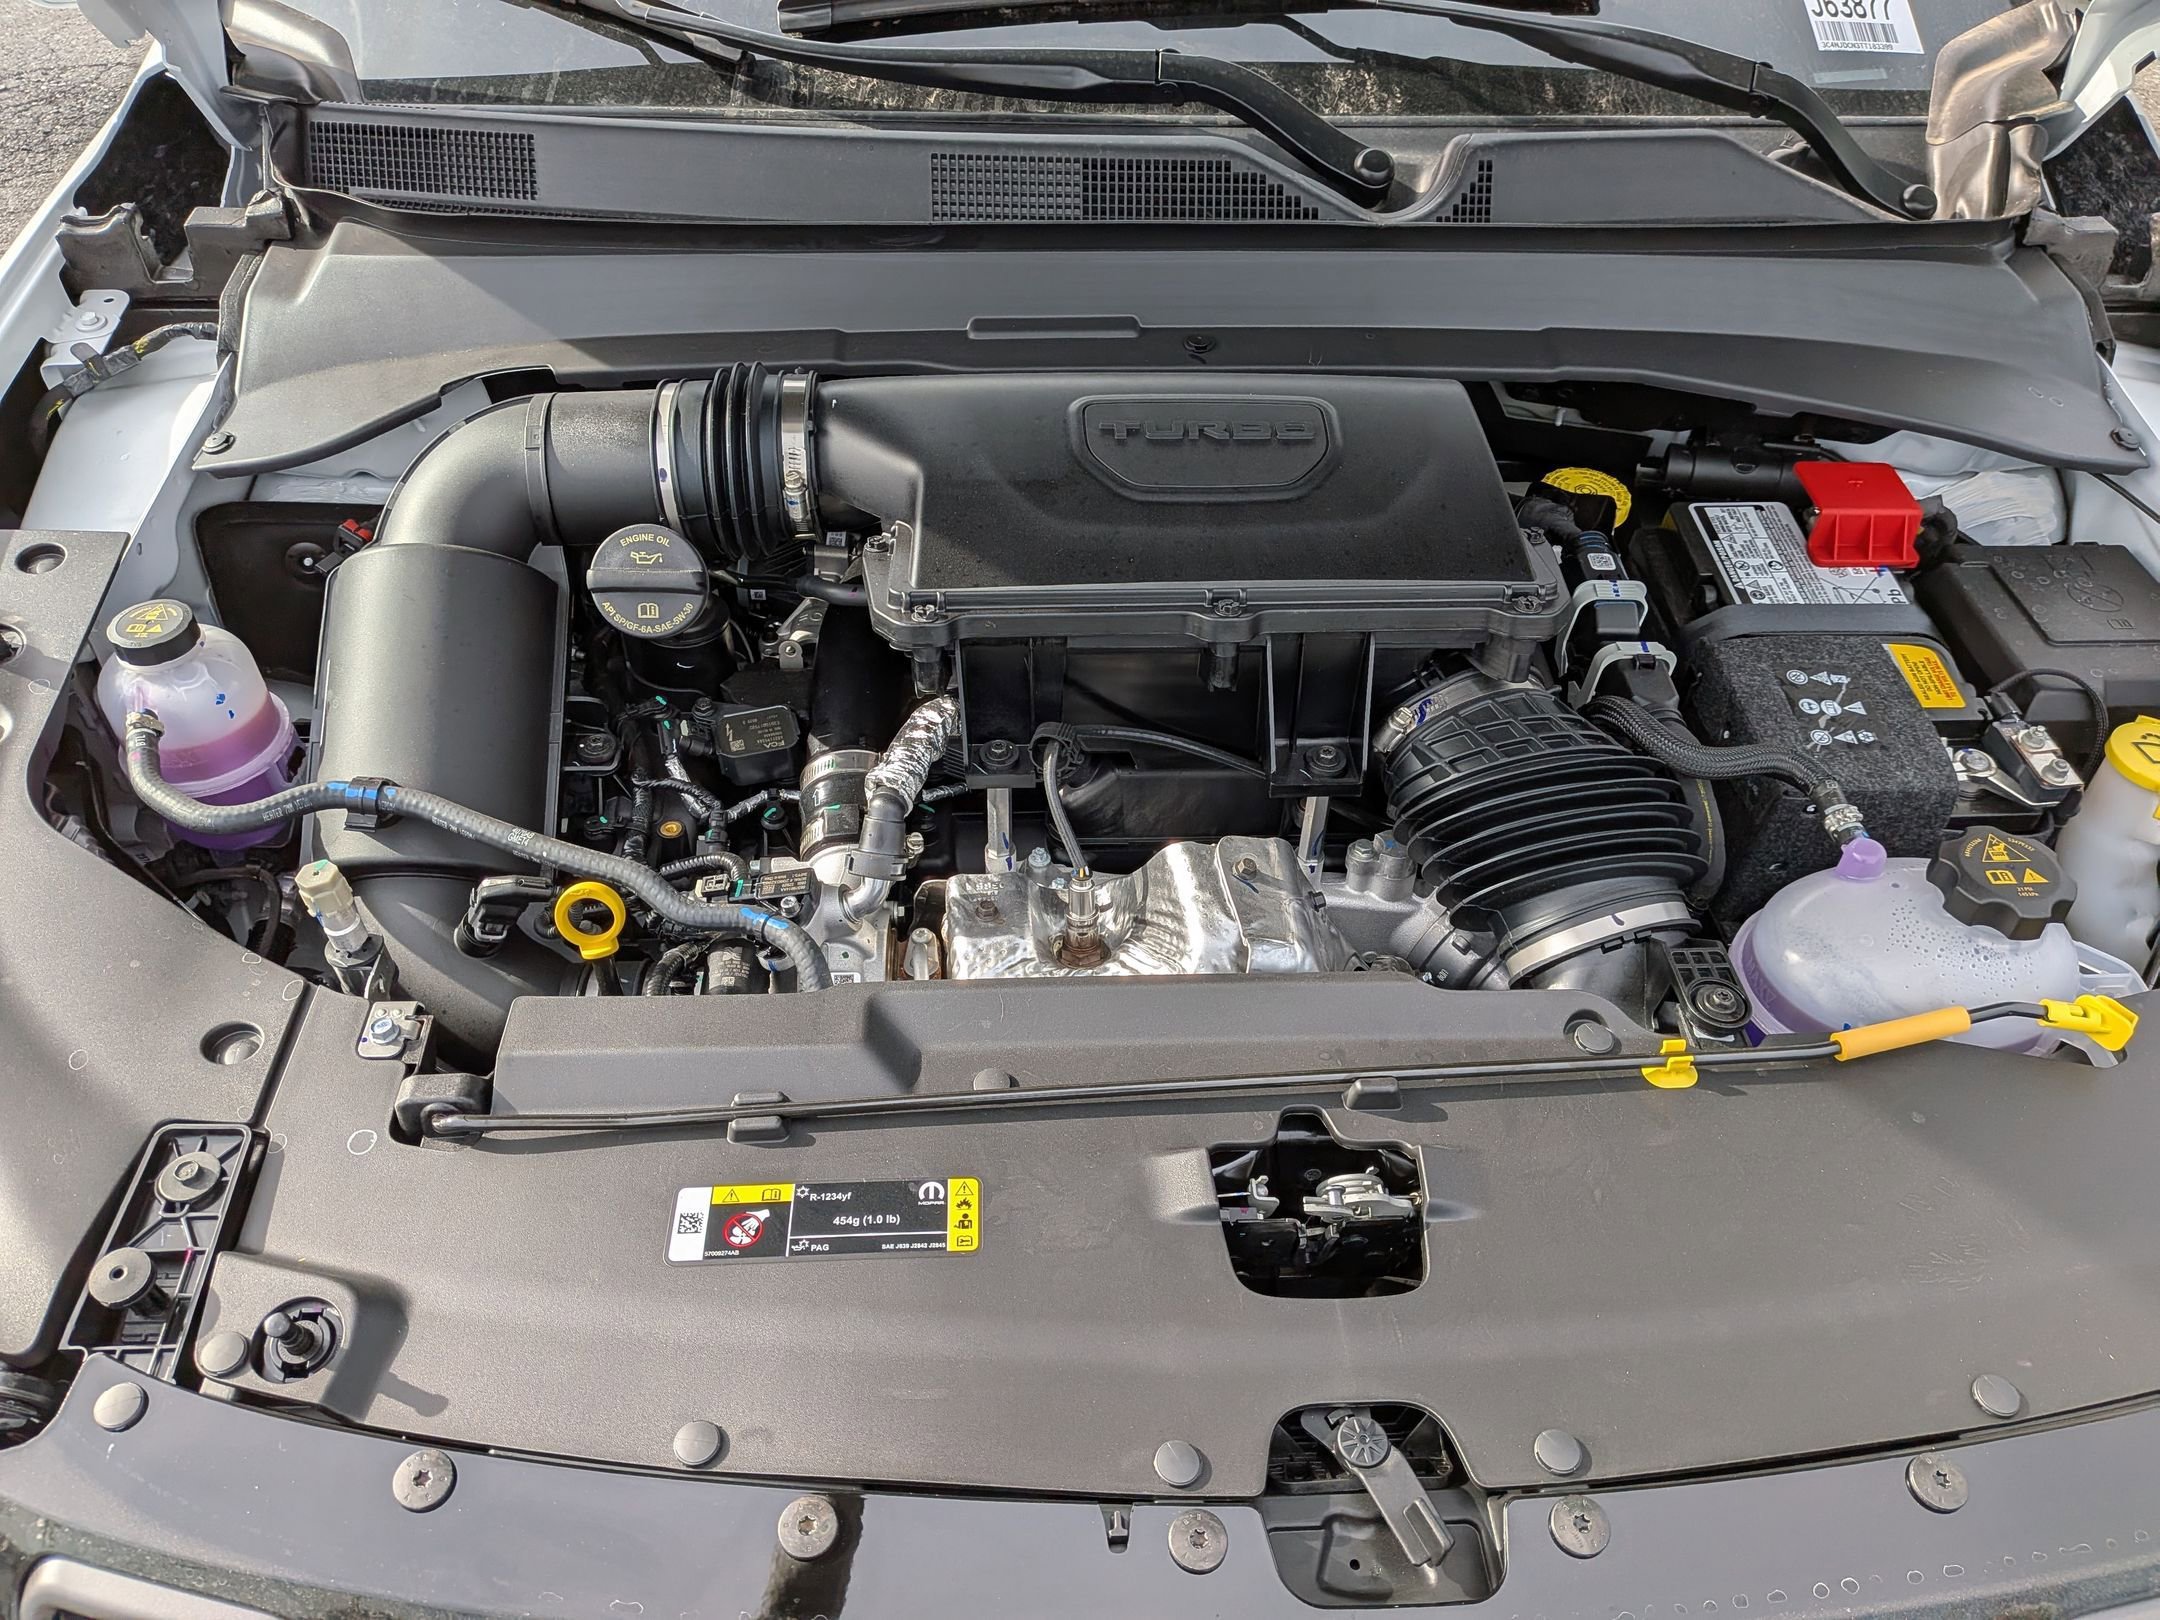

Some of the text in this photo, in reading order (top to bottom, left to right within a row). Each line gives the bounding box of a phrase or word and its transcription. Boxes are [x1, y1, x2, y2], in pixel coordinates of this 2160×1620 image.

[1099, 420, 1316, 440] TURBO
[620, 533, 671, 548] ENGINE OIL
[602, 601, 616, 617] API
[809, 1191, 852, 1202] R-1234yf
[832, 1214, 901, 1227] 454g (1.0 lb)
[810, 1244, 830, 1252] PAG
